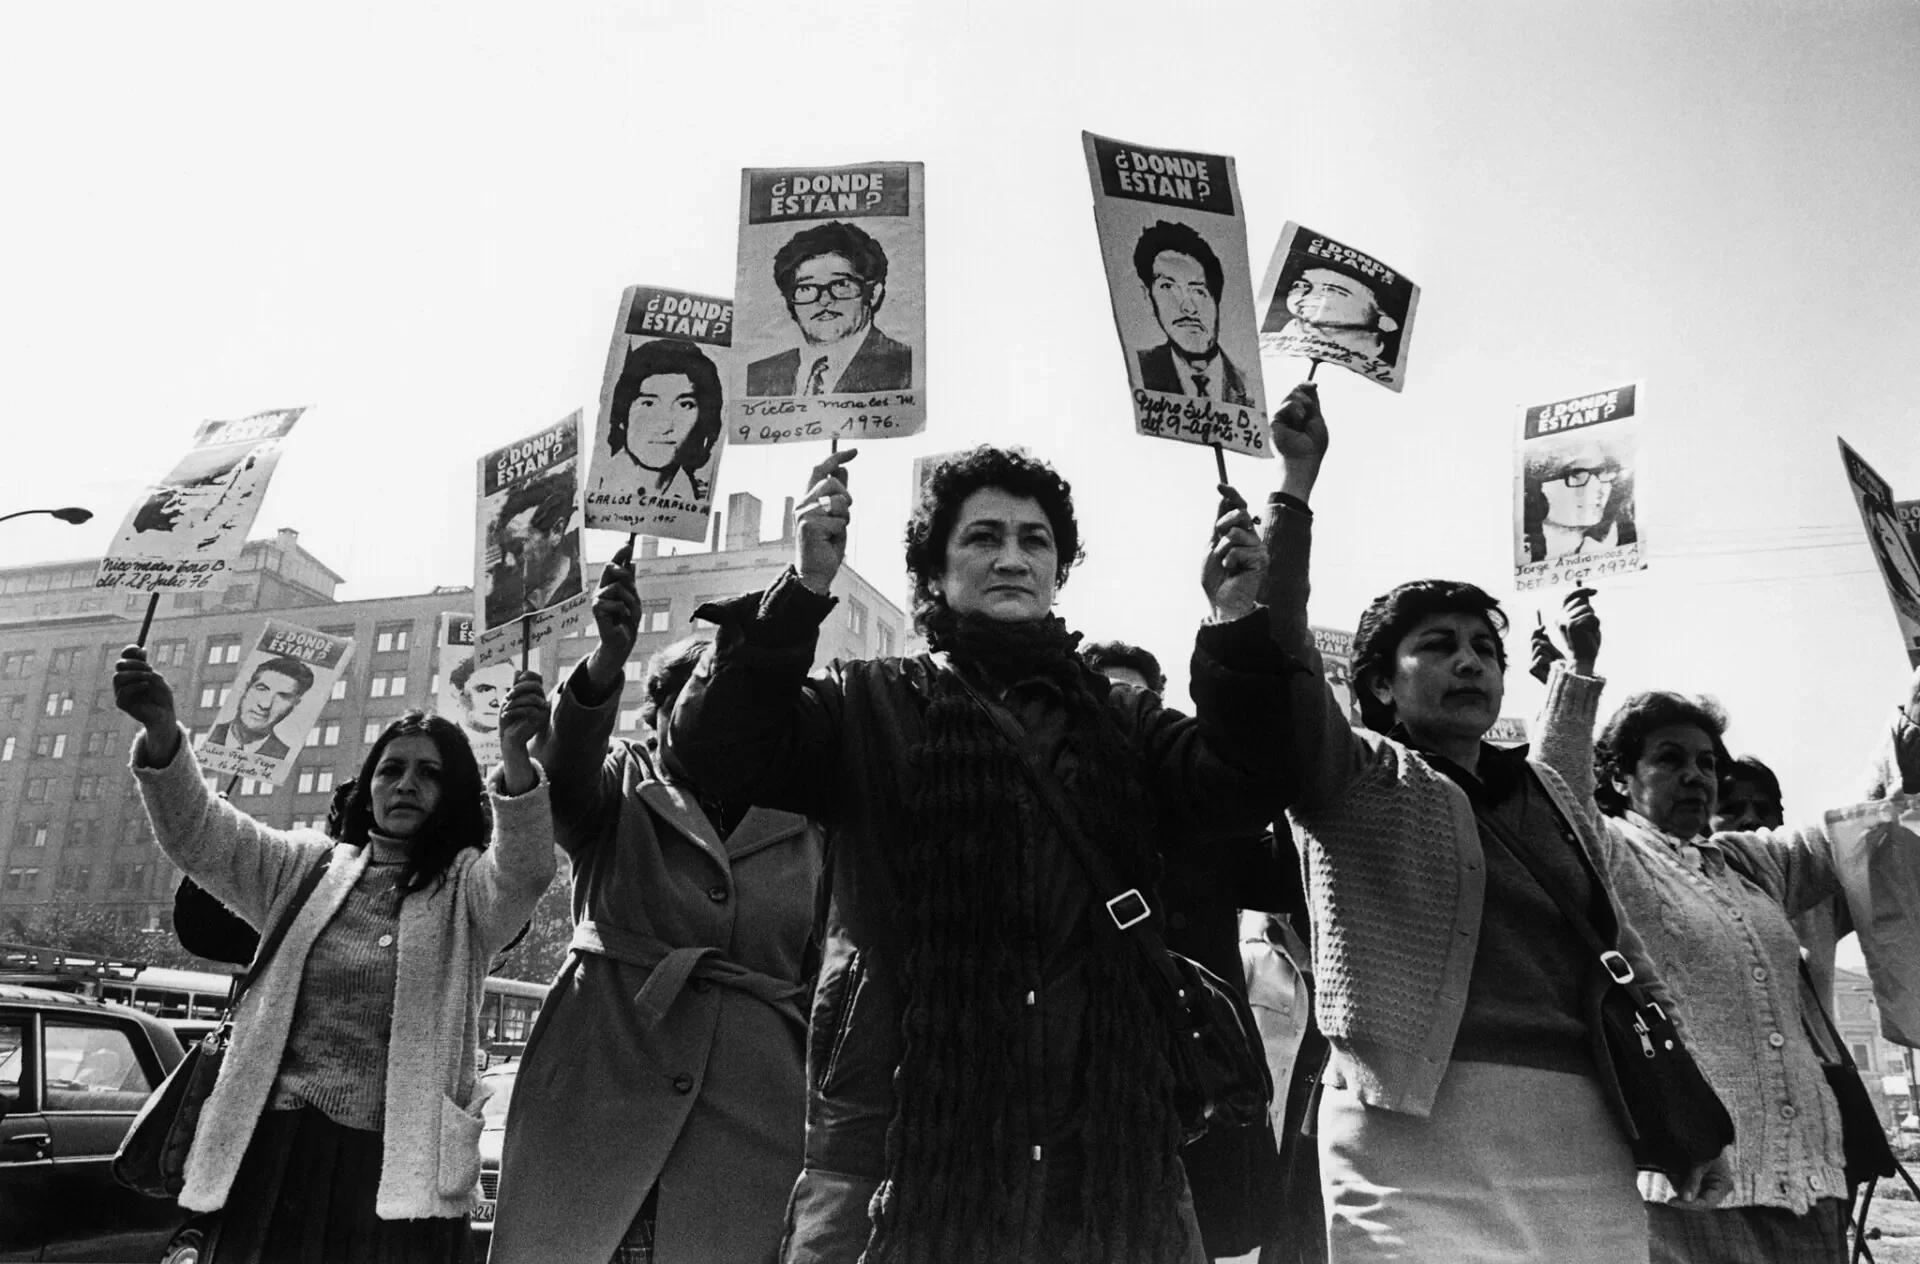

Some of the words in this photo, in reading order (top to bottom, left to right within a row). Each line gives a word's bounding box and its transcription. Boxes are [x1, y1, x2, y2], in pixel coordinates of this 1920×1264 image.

[739, 425, 751, 441] 9
[1243, 430, 1263, 449] 76
[587, 492, 632, 505] CARLOS
[1514, 564, 1549, 576] Jorge
[189, 574, 213, 588] 76
